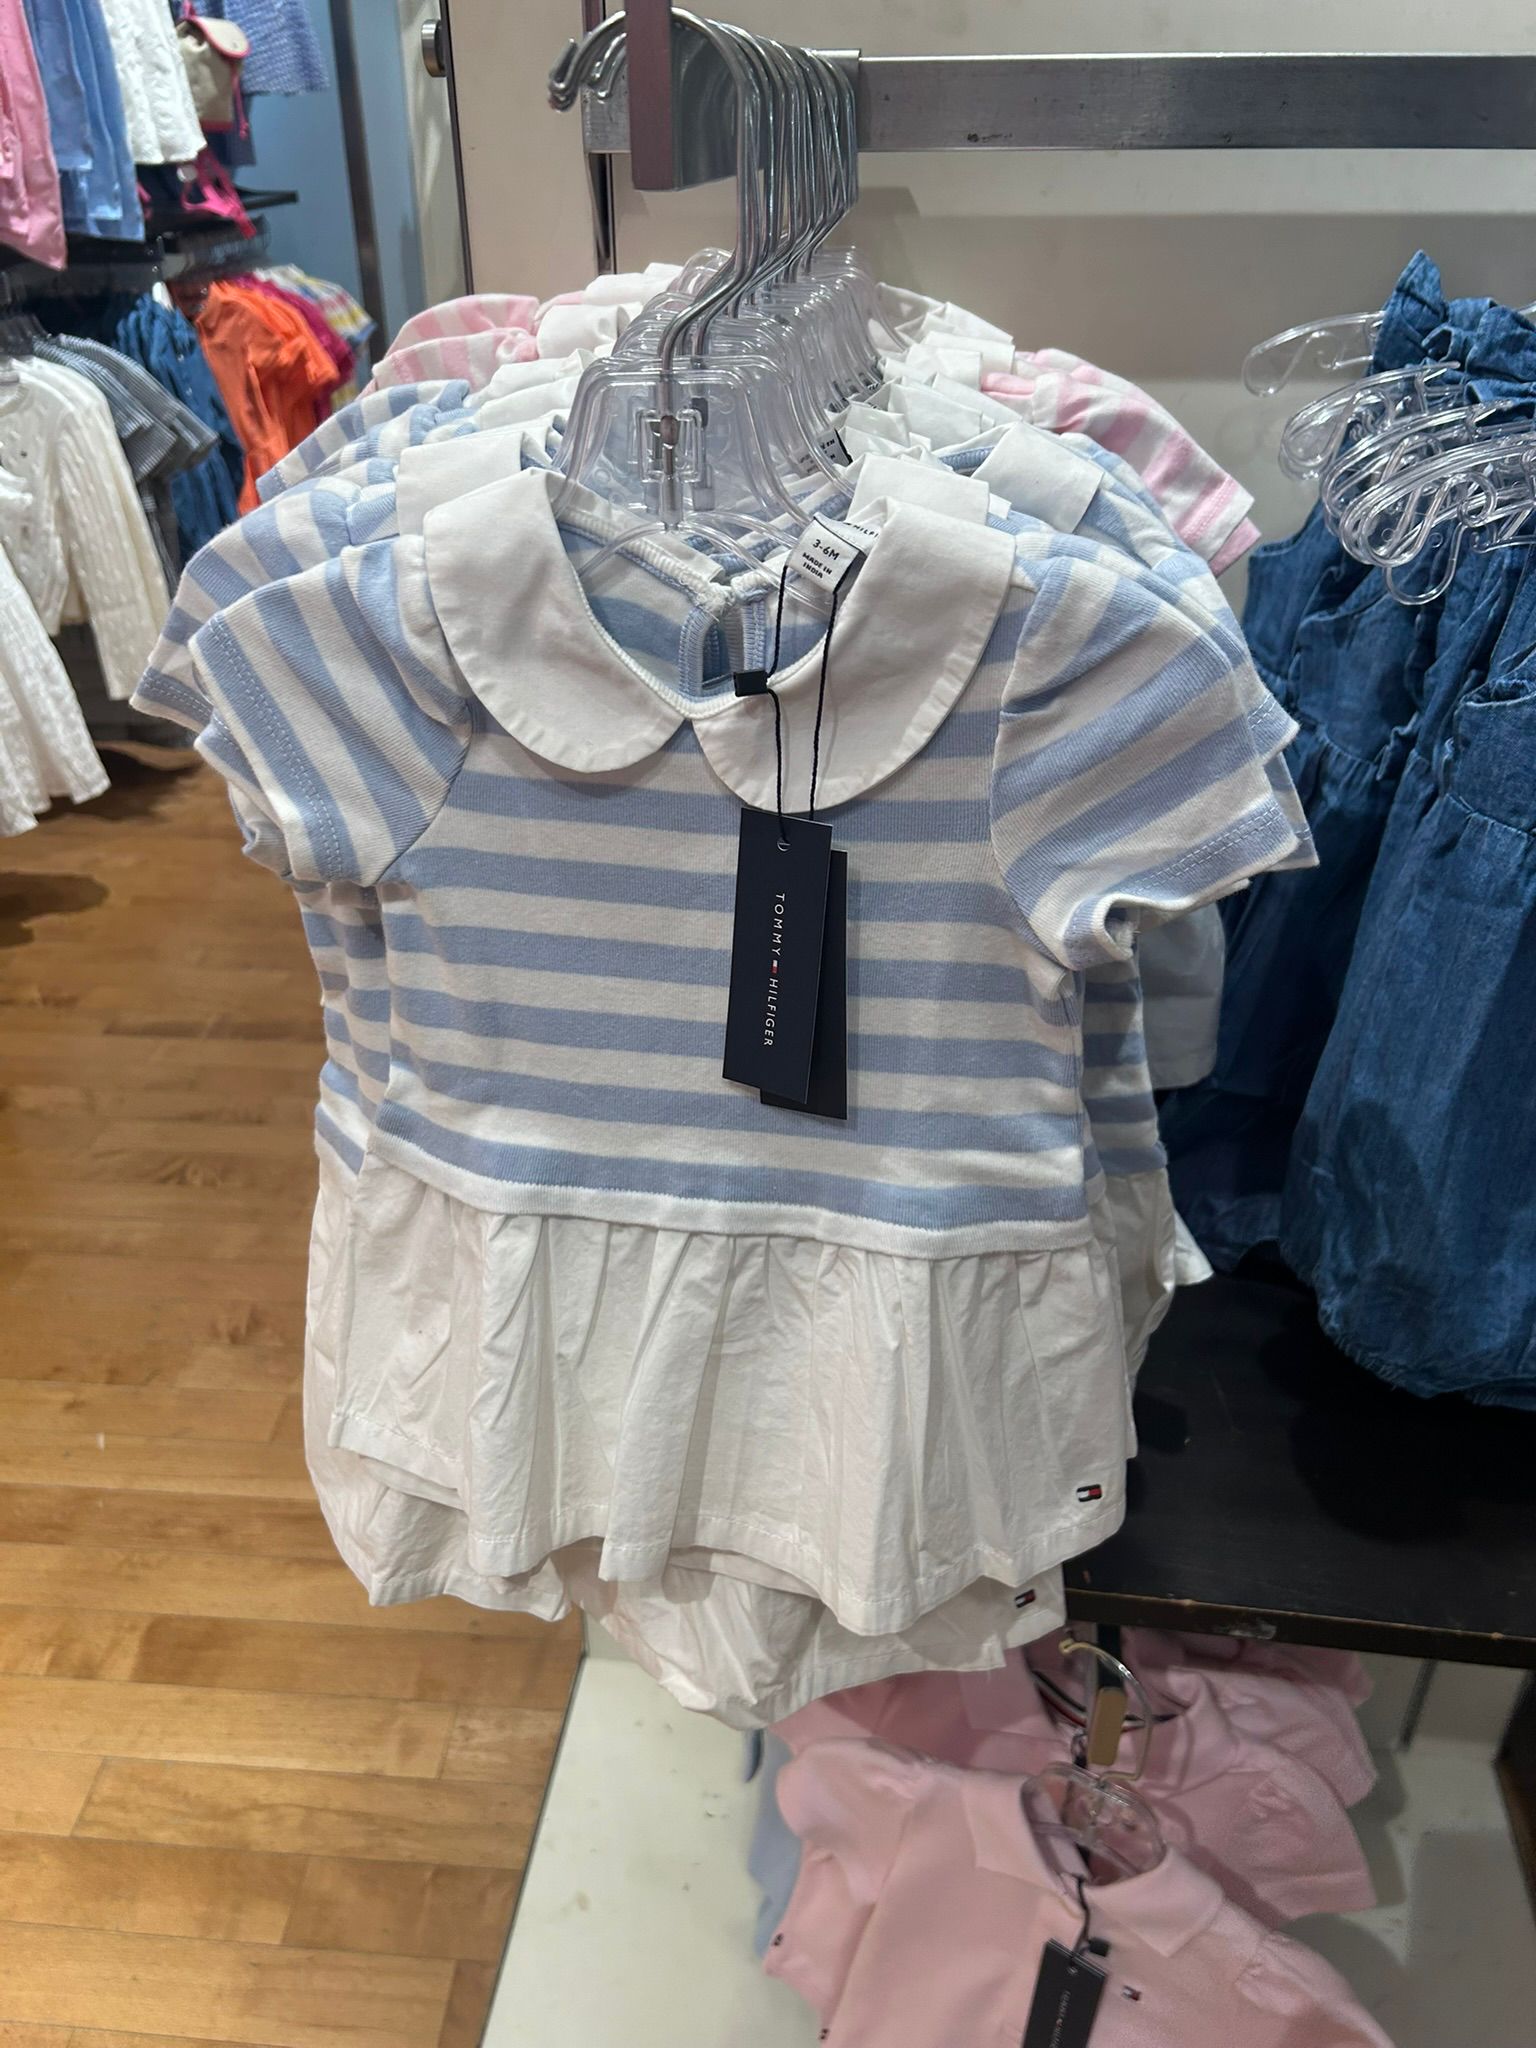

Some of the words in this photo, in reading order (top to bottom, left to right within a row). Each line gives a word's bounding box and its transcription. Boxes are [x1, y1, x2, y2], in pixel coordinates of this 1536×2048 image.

[853, 524, 880, 538] HILFI
[813, 539, 840, 560] 3-6M
[802, 552, 823, 568] MADE
[823, 564, 833, 575] IN
[803, 562, 823, 578] INDIA
[771, 893, 786, 957] TOMMY
[763, 978, 779, 1046] HILFIGER
